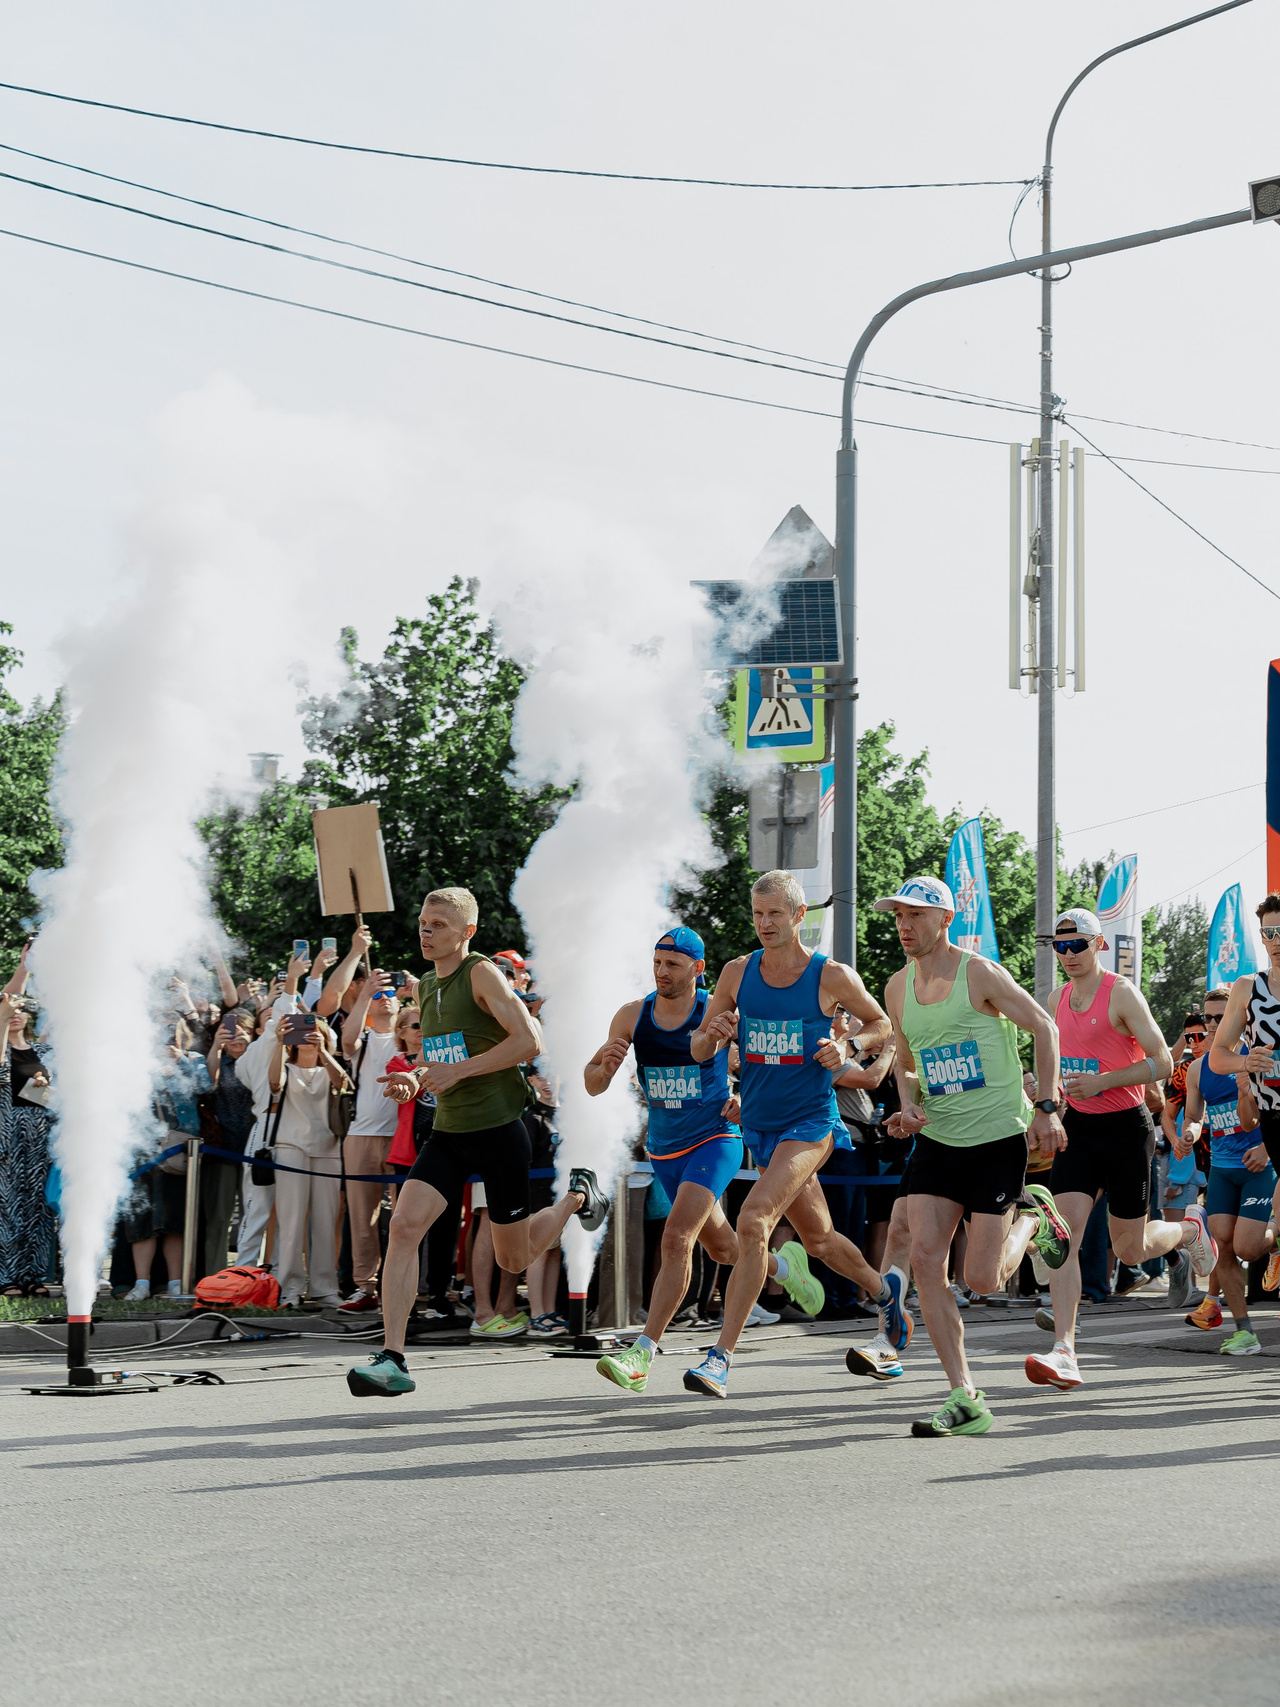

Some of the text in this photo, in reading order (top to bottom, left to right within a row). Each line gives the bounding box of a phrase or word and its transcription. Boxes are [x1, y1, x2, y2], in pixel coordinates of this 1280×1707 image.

[748, 1030, 800, 1054] 30264
[926, 1054, 978, 1085] 50051
[648, 1077, 698, 1099] 50294
[943, 1082, 964, 1095] 10KM
[664, 1099, 682, 1109] 10KM
